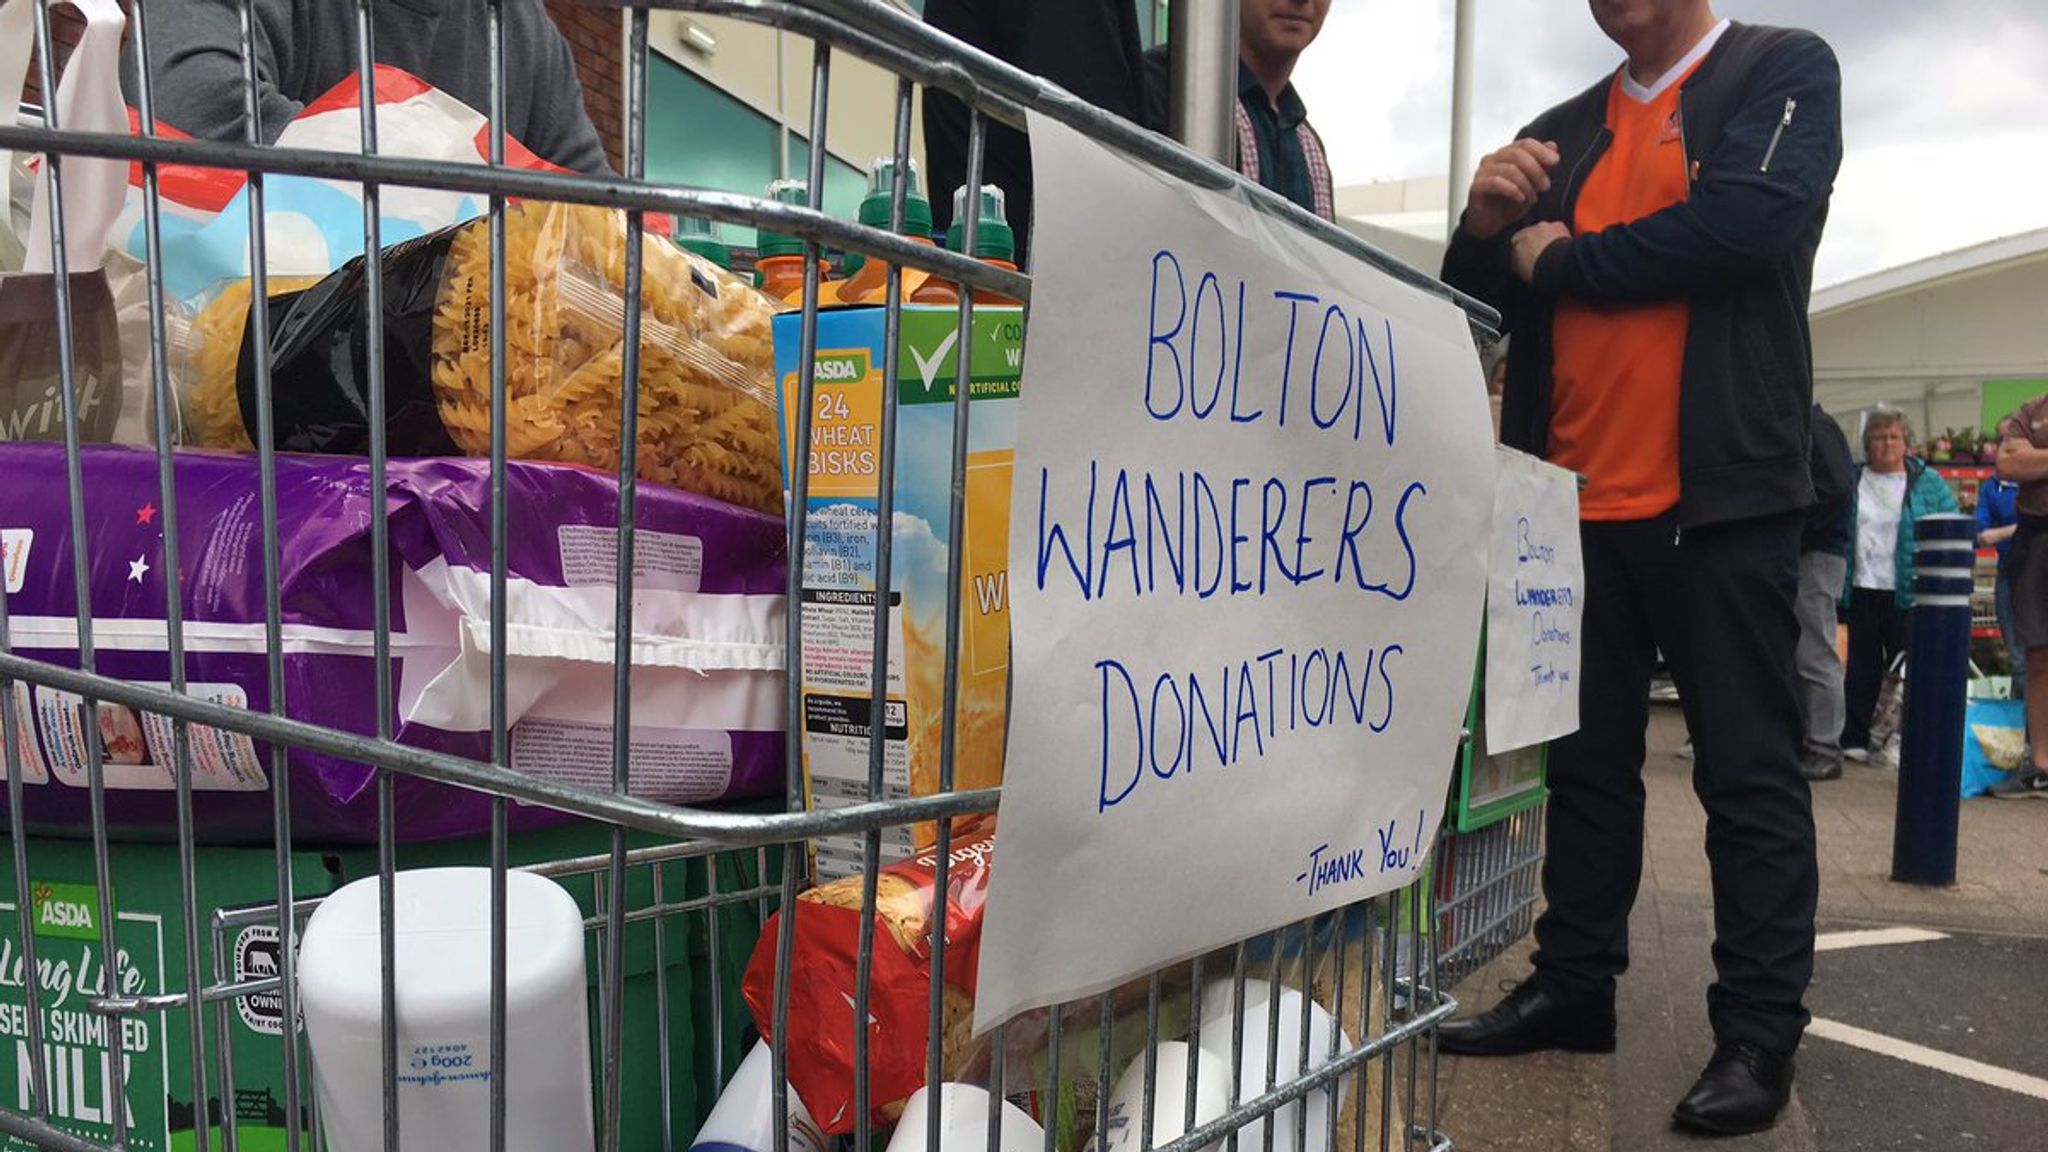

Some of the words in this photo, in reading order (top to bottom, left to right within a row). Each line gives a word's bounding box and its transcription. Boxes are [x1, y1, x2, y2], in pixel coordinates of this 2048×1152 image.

[1145, 250, 1396, 445] BOLTON
[814, 360, 857, 379] ASDA
[970, 382, 1010, 394] RTIFICIAL
[818, 393, 850, 420] 24
[808, 450, 875, 475] BISKS
[1038, 460, 1426, 600] WANDERERS
[1096, 645, 1403, 813] DONATIONS
[41, 900, 93, 928] ASDA
[431, 1054, 473, 1069] 200g
